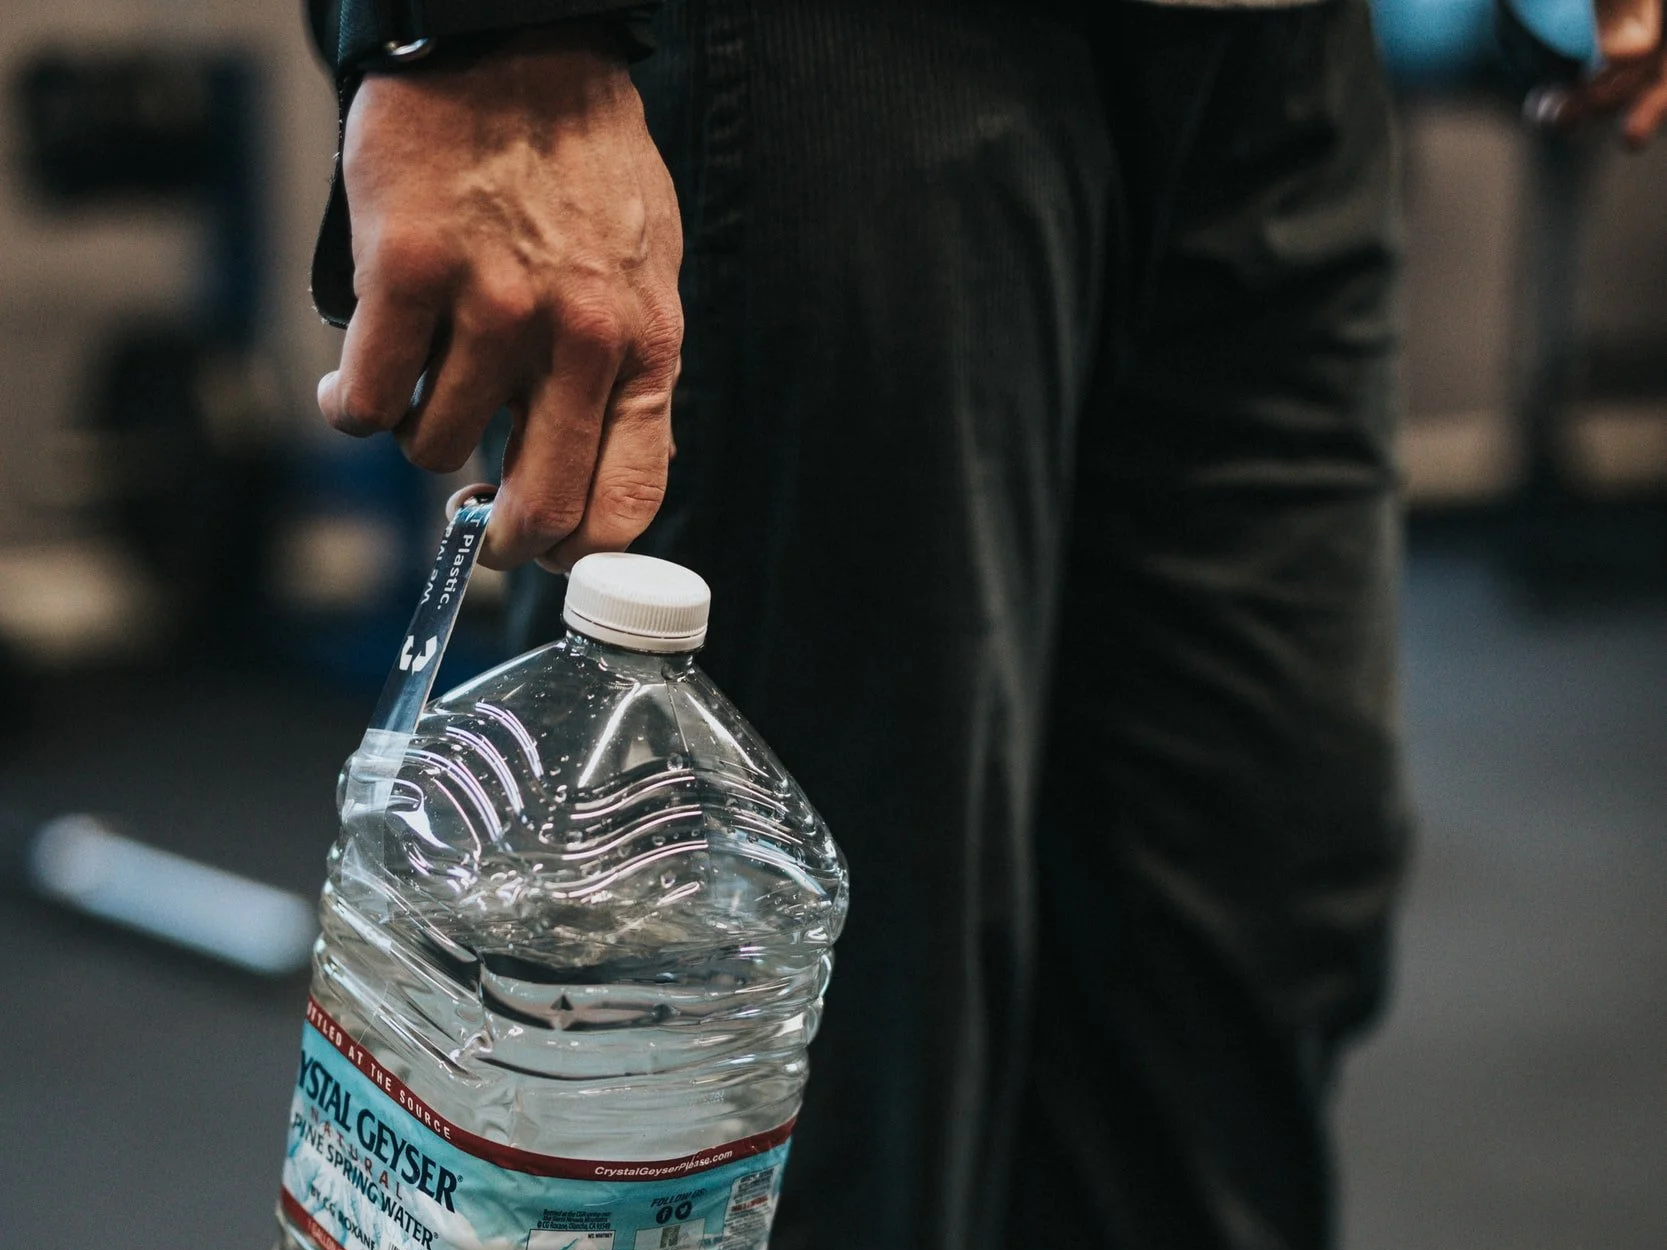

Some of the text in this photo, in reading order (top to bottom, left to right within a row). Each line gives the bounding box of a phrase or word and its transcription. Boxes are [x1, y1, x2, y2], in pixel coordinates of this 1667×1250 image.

[437, 534, 475, 610] Plastic.
[348, 1046, 363, 1065] AT
[371, 1063, 392, 1092] THE
[400, 1090, 451, 1140] SOURCE
[310, 1106, 403, 1200] NATURAL
[326, 1144, 378, 1204] SPRING
[594, 1150, 734, 1177] CrystalGeyserPlease.com
